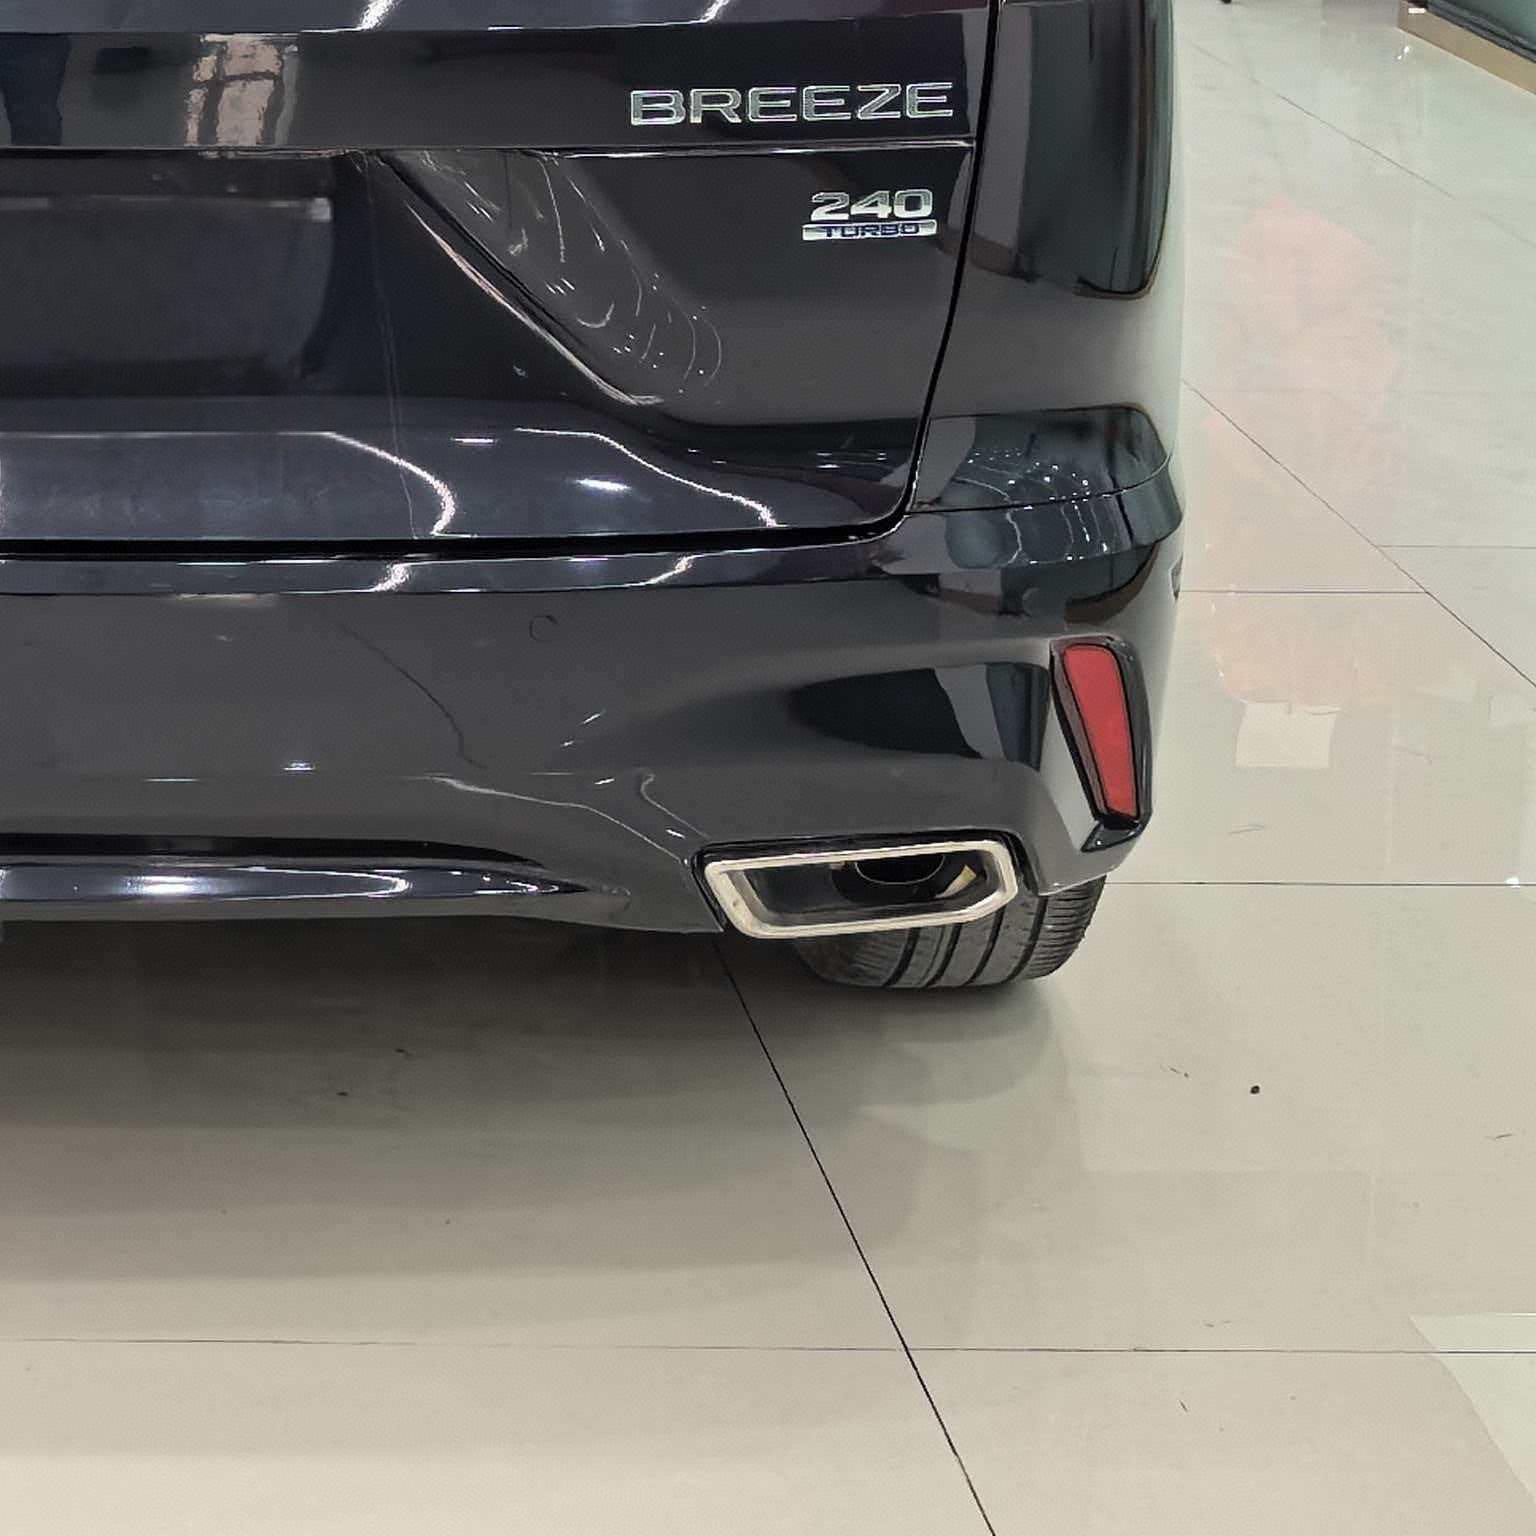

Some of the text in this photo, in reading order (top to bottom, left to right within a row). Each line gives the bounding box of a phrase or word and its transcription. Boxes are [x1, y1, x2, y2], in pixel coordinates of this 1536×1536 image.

[630, 81, 954, 126] BREEZE
[810, 188, 934, 221] 240
[822, 223, 920, 238] TURBO
